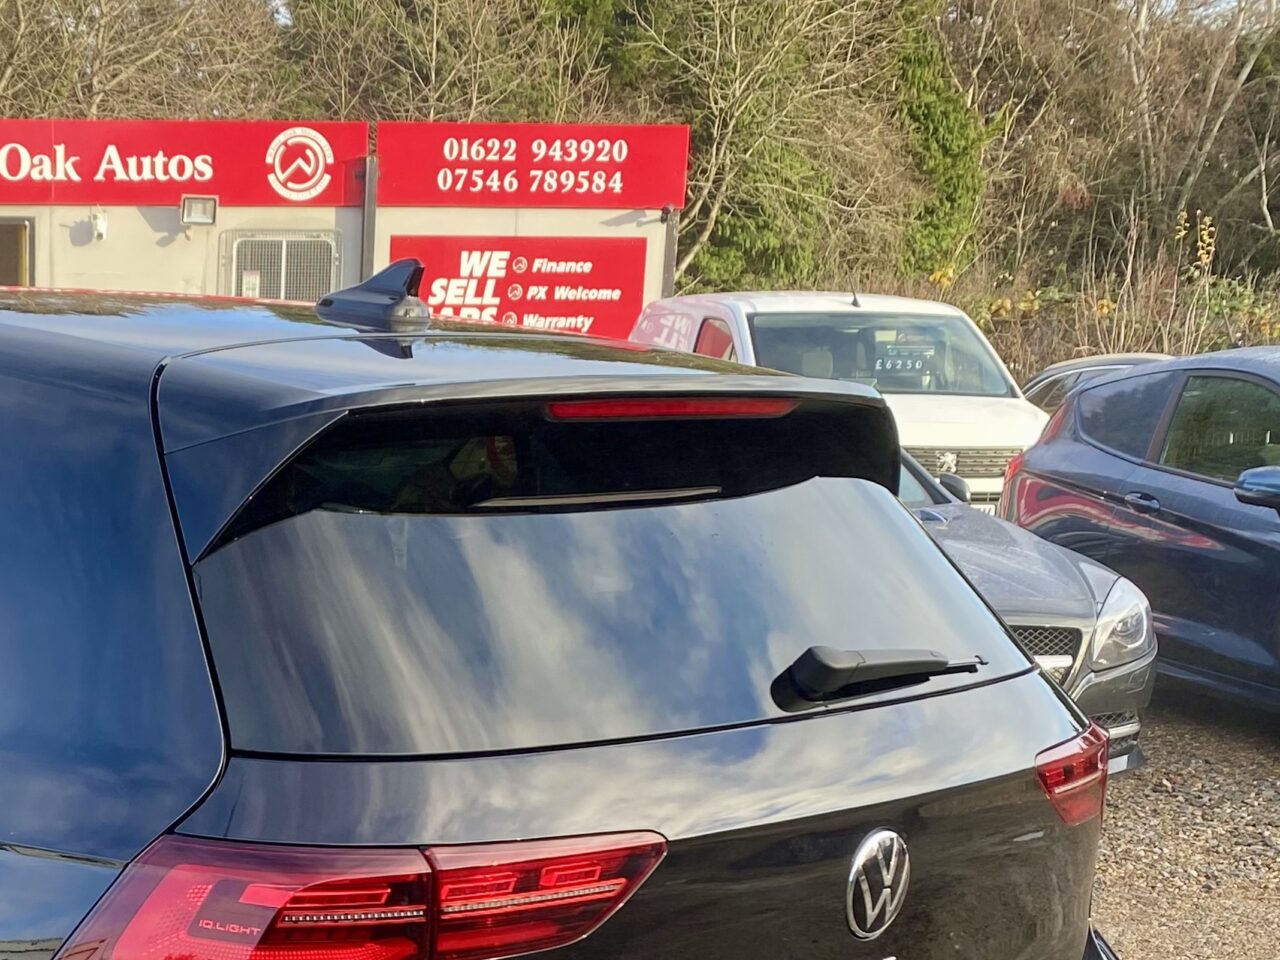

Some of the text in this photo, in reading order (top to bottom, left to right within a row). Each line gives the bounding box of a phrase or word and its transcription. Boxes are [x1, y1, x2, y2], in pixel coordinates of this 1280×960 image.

[443, 138, 628, 162] 01622 943920
[93, 144, 214, 181] Autos
[437, 168, 624, 193] 07546 789584
[459, 250, 512, 277] WE
[531, 257, 593, 273] Finance
[428, 278, 500, 305] SELL
[526, 285, 622, 301] PX Welcome
[523, 313, 594, 333] Warranty
[875, 359, 923, 370] £6250
[199, 919, 261, 936] IQ.LIGHT
